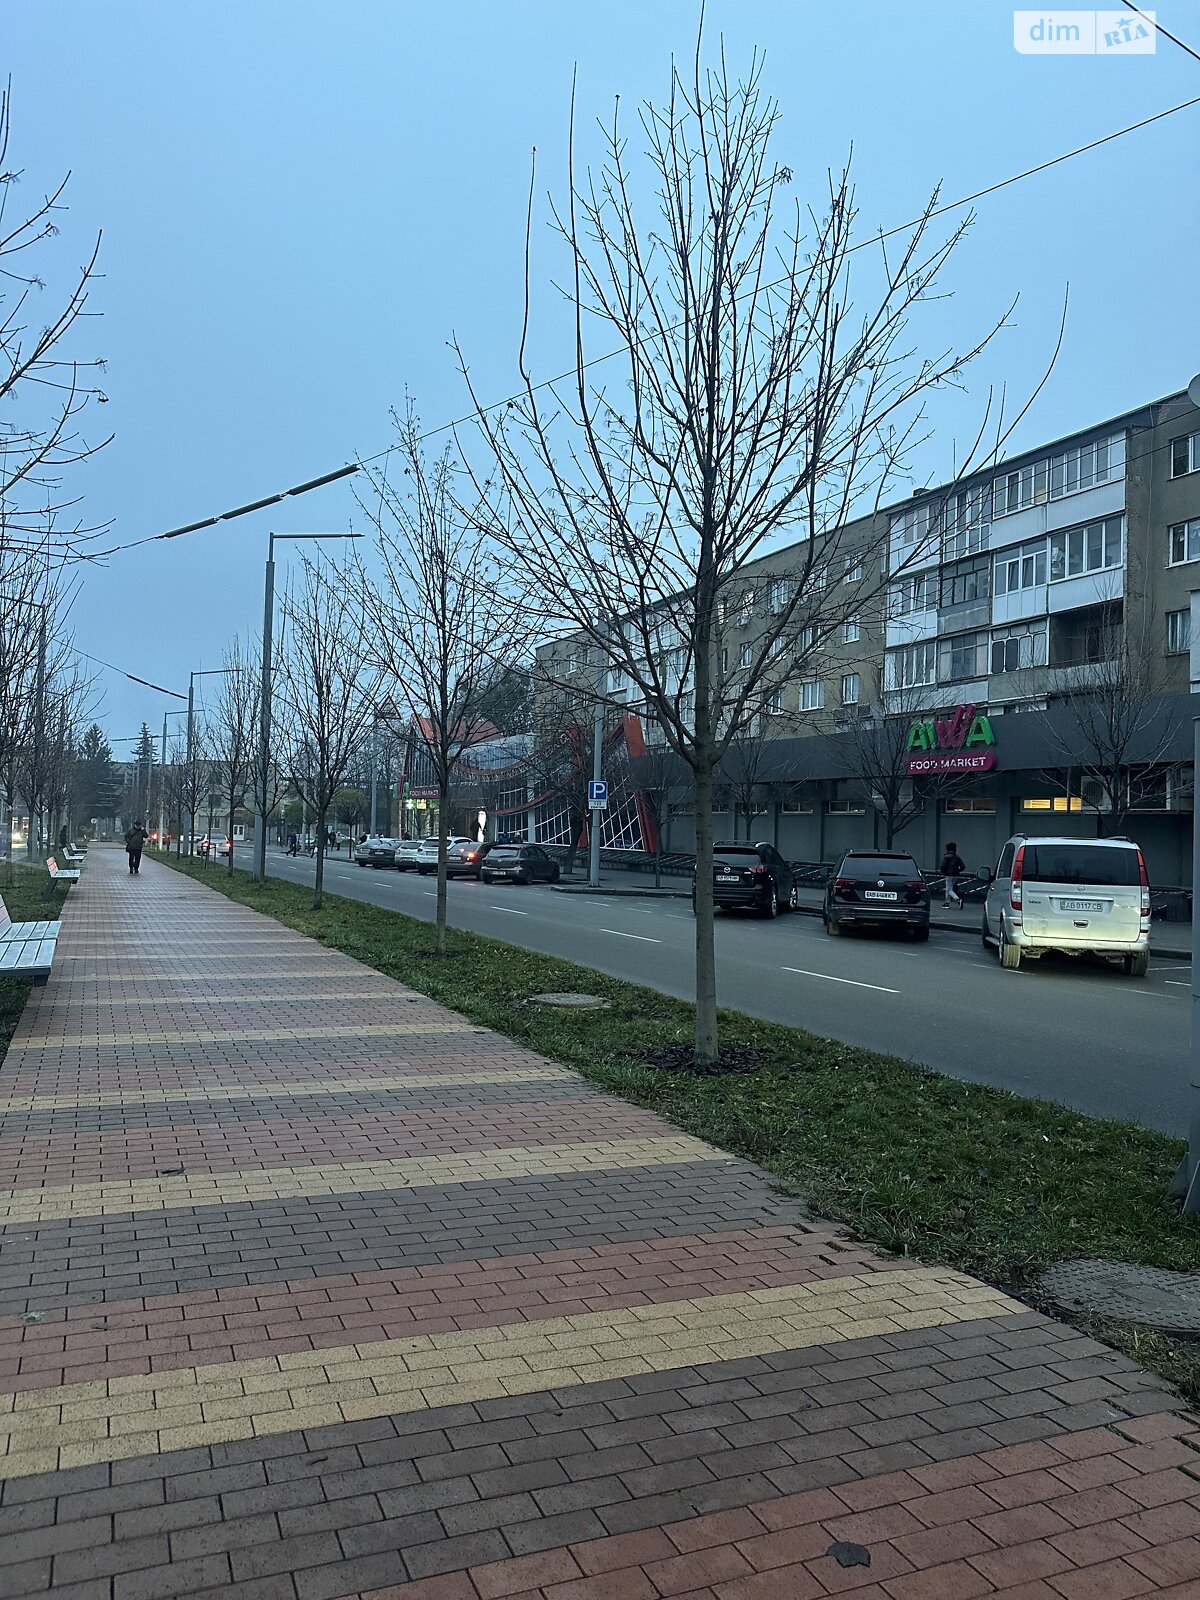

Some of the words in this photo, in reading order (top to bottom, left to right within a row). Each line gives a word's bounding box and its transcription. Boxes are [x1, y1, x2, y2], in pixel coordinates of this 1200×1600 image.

[910, 760, 937, 770] FOOD
[941, 757, 986, 769] MARKET
[593, 782, 606, 799] P
[1076, 901, 1092, 909] 0117
